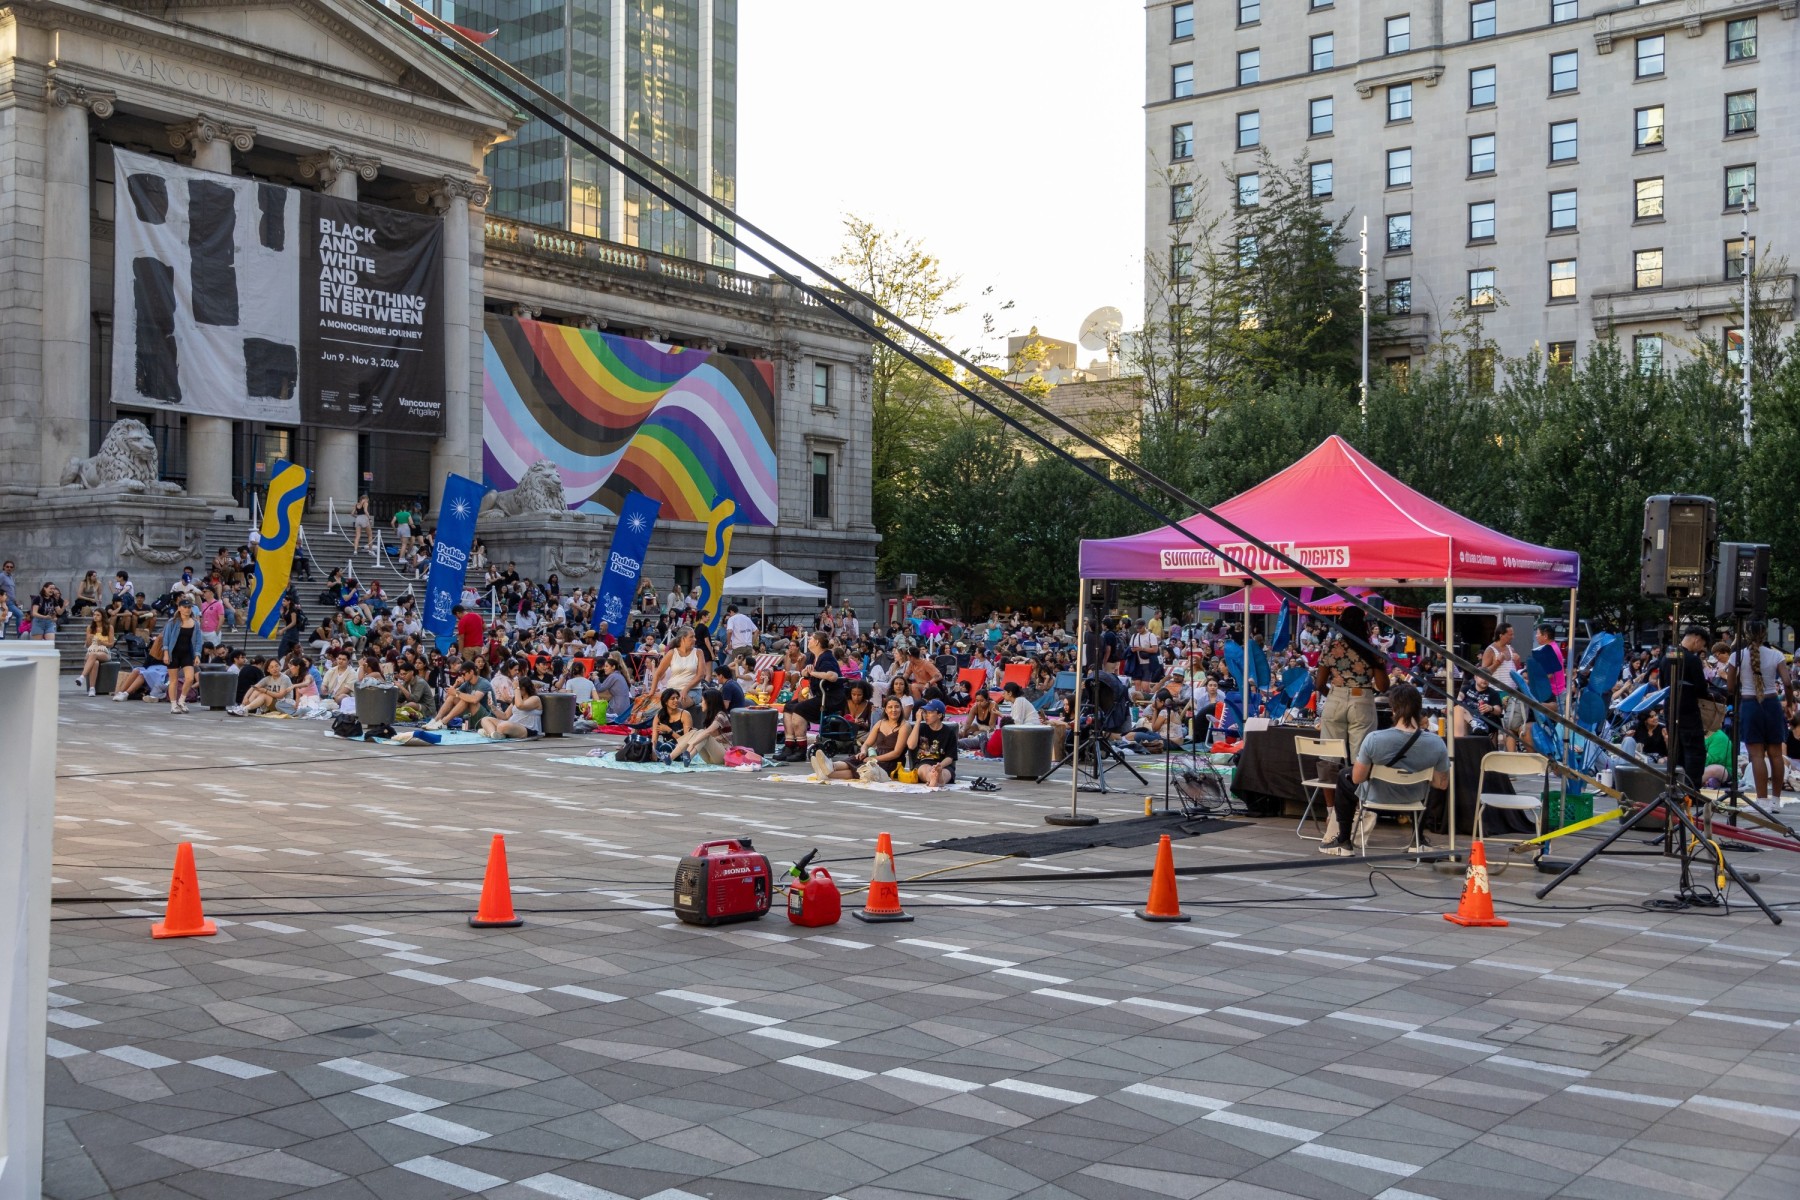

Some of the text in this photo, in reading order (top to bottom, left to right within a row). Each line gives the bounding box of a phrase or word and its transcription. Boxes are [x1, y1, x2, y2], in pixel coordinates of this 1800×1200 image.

[116, 49, 433, 150] VANCOUVER ART GALLERY
[320, 218, 376, 244] BLACK
[320, 234, 358, 255] AND
[320, 249, 376, 274] WHITE
[320, 265, 358, 286] AND
[320, 281, 426, 310] EVERYTHING
[320, 297, 423, 325] IN BETWEEN
[320, 319, 423, 339] A MONOCHROME JOURNEY
[321, 351, 337, 361] Jun
[339, 353, 345, 362] 9
[352, 355, 369, 365] Nov
[370, 357, 379, 367] 3,
[381, 358, 399, 368] 2024
[399, 397, 441, 408] Vancouver
[408, 407, 440, 418] Artgallery
[437, 542, 466, 561] Public
[611, 552, 640, 570] Public
[1164, 543, 1344, 573] SUMMER MOVIE NIGHTS
[437, 553, 462, 571] Disco
[610, 562, 635, 578] Disco
[723, 867, 751, 875] HONDA
